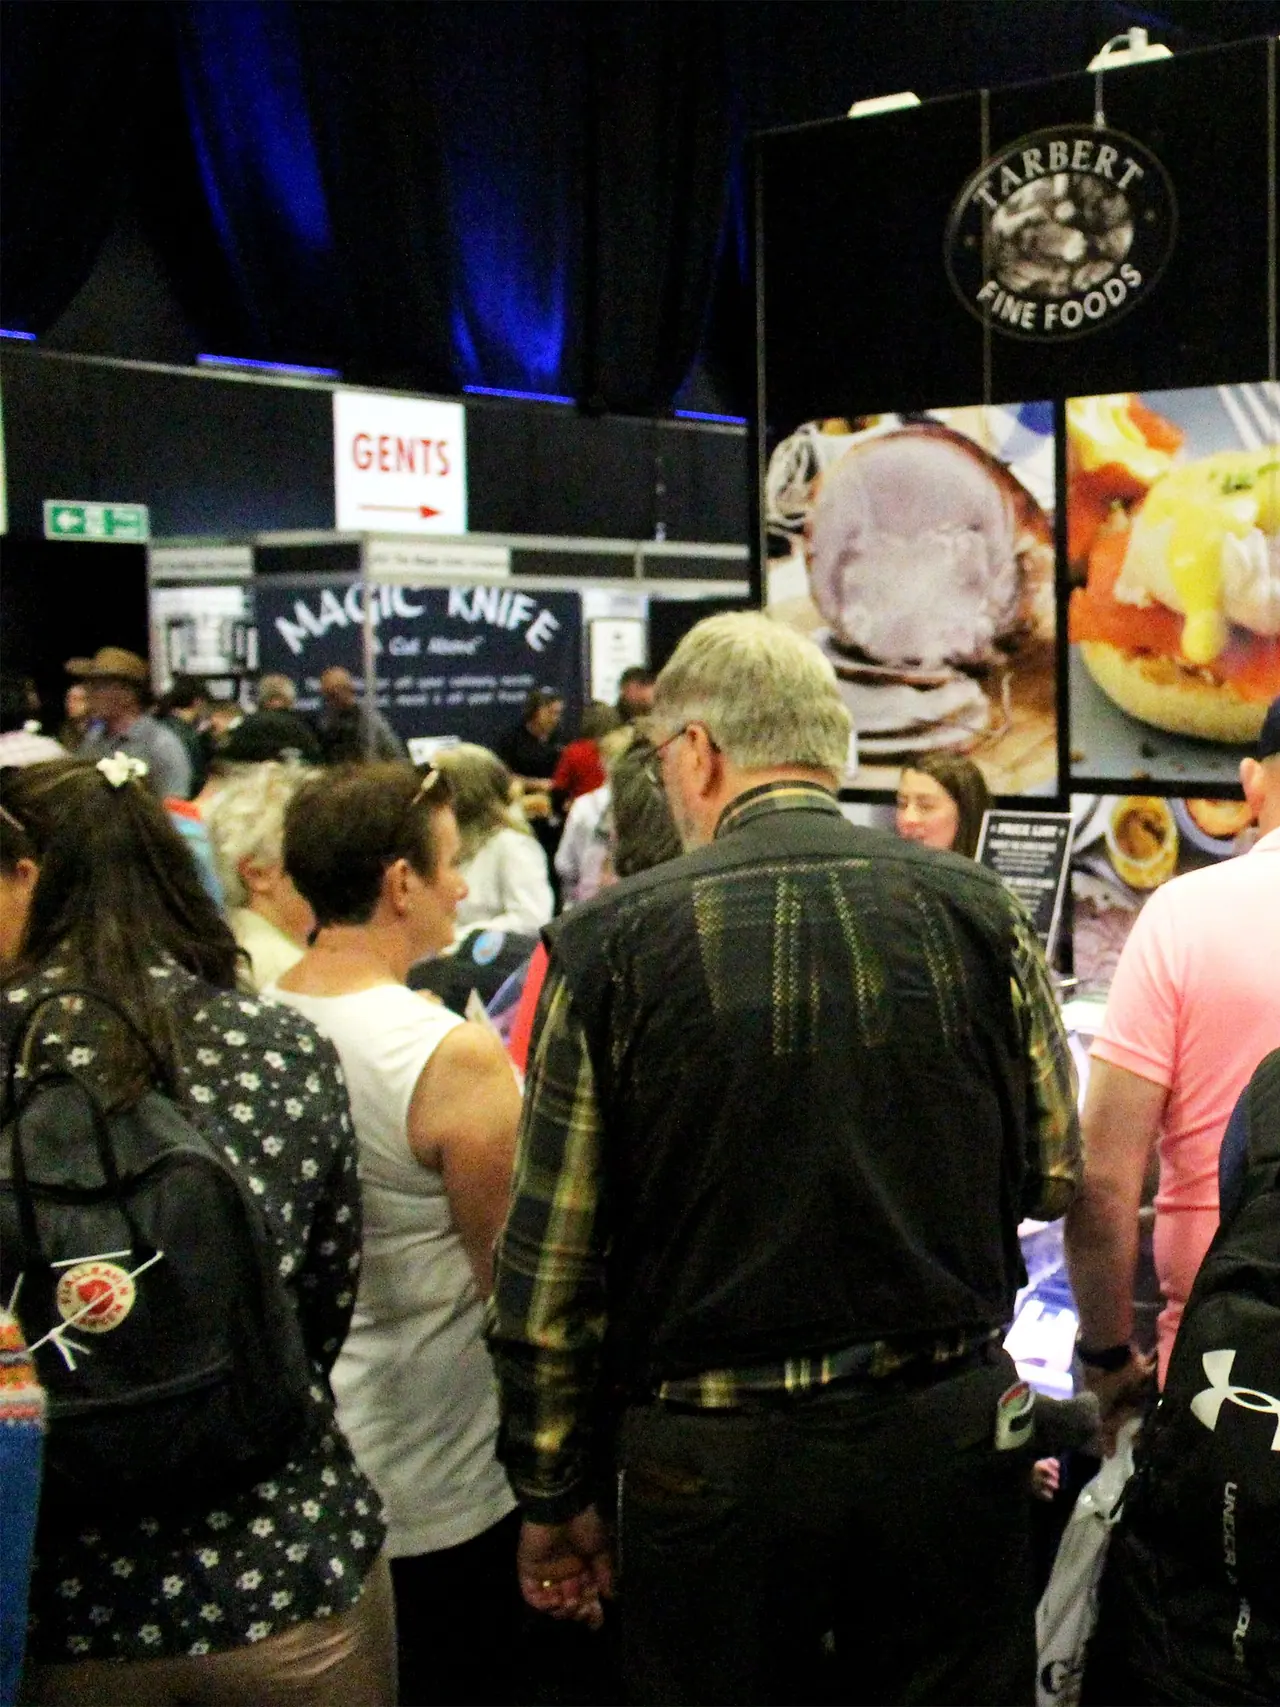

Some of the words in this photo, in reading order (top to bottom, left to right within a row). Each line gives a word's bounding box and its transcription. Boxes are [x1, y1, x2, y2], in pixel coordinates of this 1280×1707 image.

[972, 138, 1145, 208] TARBERT
[976, 280, 1038, 330] FINE
[1044, 263, 1143, 330] FOODS
[352, 432, 451, 477] GENTS
[274, 583, 425, 654] MAGIC
[447, 583, 560, 651] KNIFE
